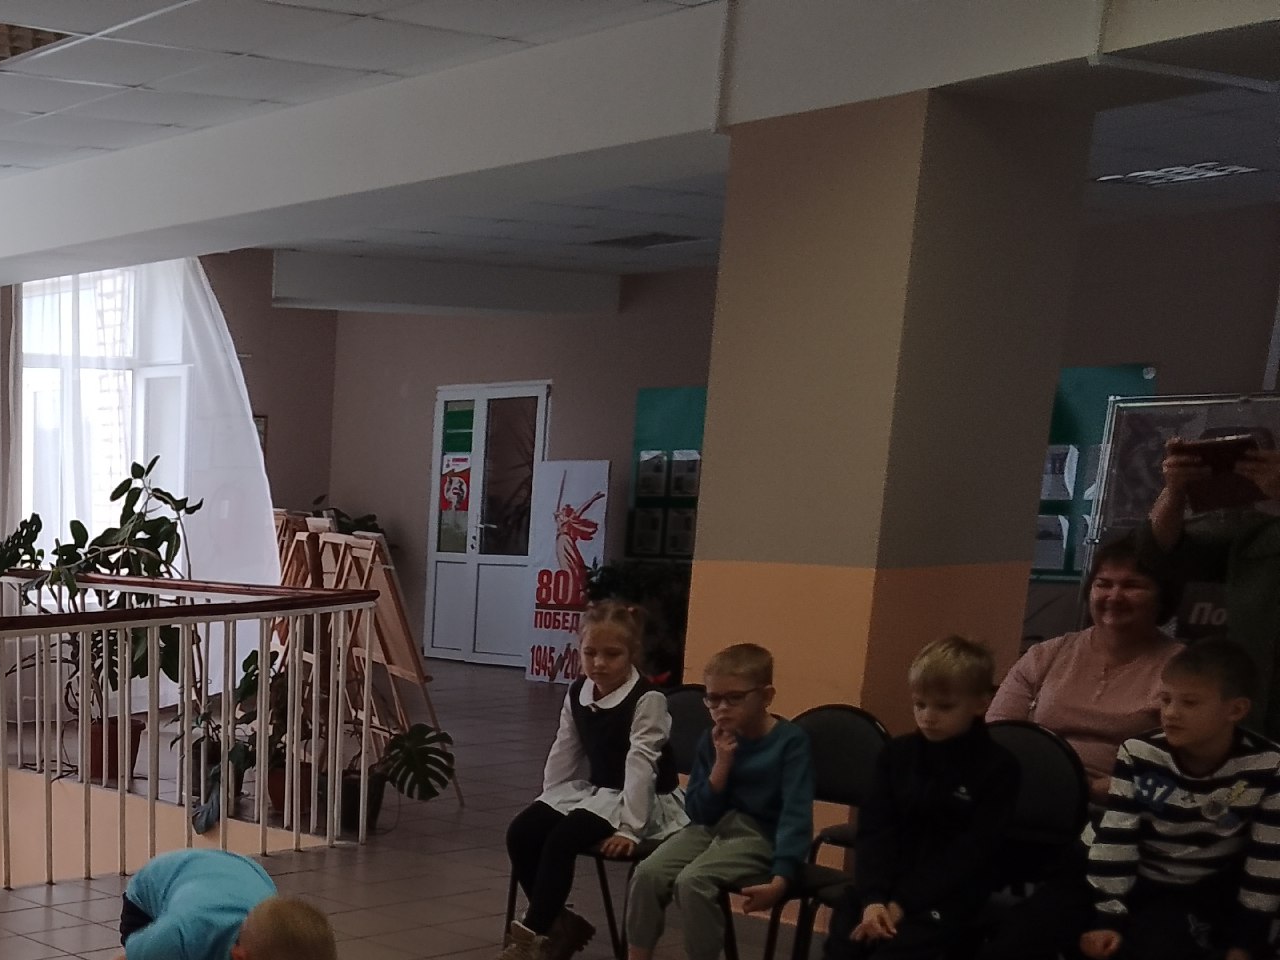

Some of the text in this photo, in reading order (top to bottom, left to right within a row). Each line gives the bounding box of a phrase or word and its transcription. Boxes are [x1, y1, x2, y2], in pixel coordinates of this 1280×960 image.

[536, 569, 570, 605] 80
[534, 611, 581, 633] ПОБЕД
[1188, 601, 1227, 626] По
